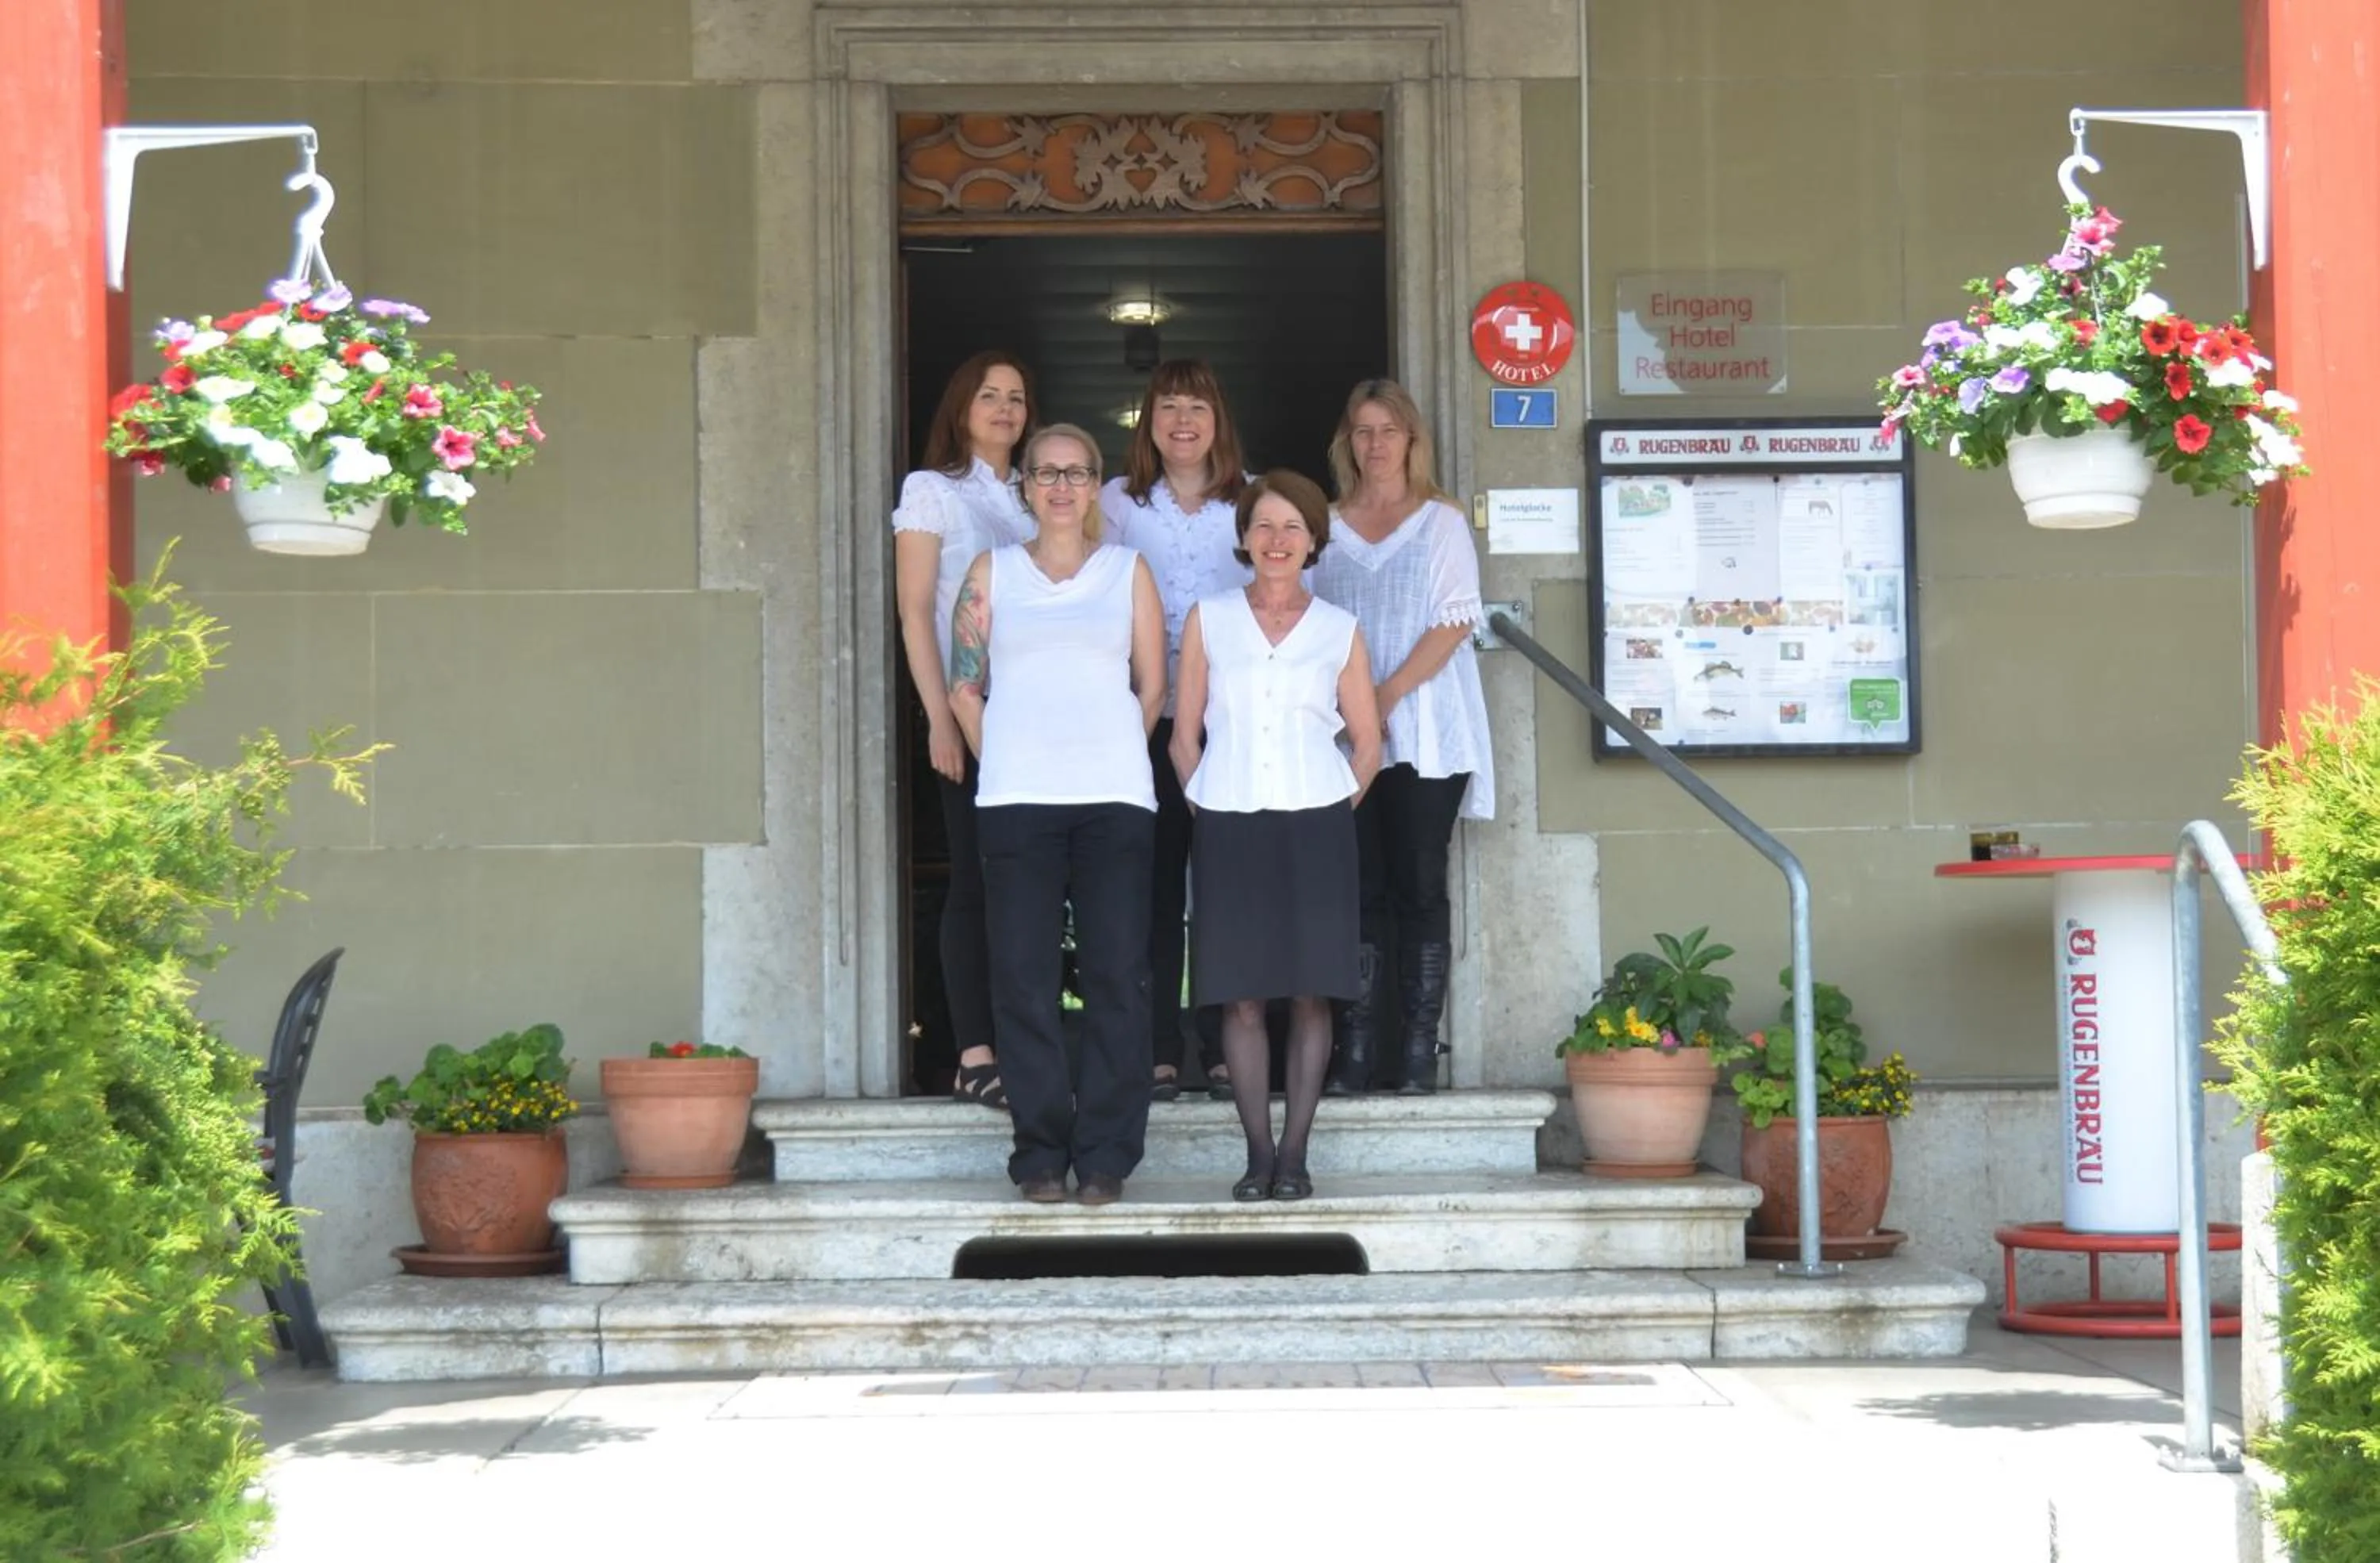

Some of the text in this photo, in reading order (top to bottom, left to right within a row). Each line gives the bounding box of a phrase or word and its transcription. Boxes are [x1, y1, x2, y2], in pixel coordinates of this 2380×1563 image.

[1651, 291, 1753, 322] Eingang
[1669, 322, 1735, 348] Hotel
[1491, 359, 1556, 382] HOTEL
[1636, 356, 1771, 379] Restaurant
[1517, 394, 1532, 423] 7
[2070, 974, 2103, 1184] RUGENBRÄU
